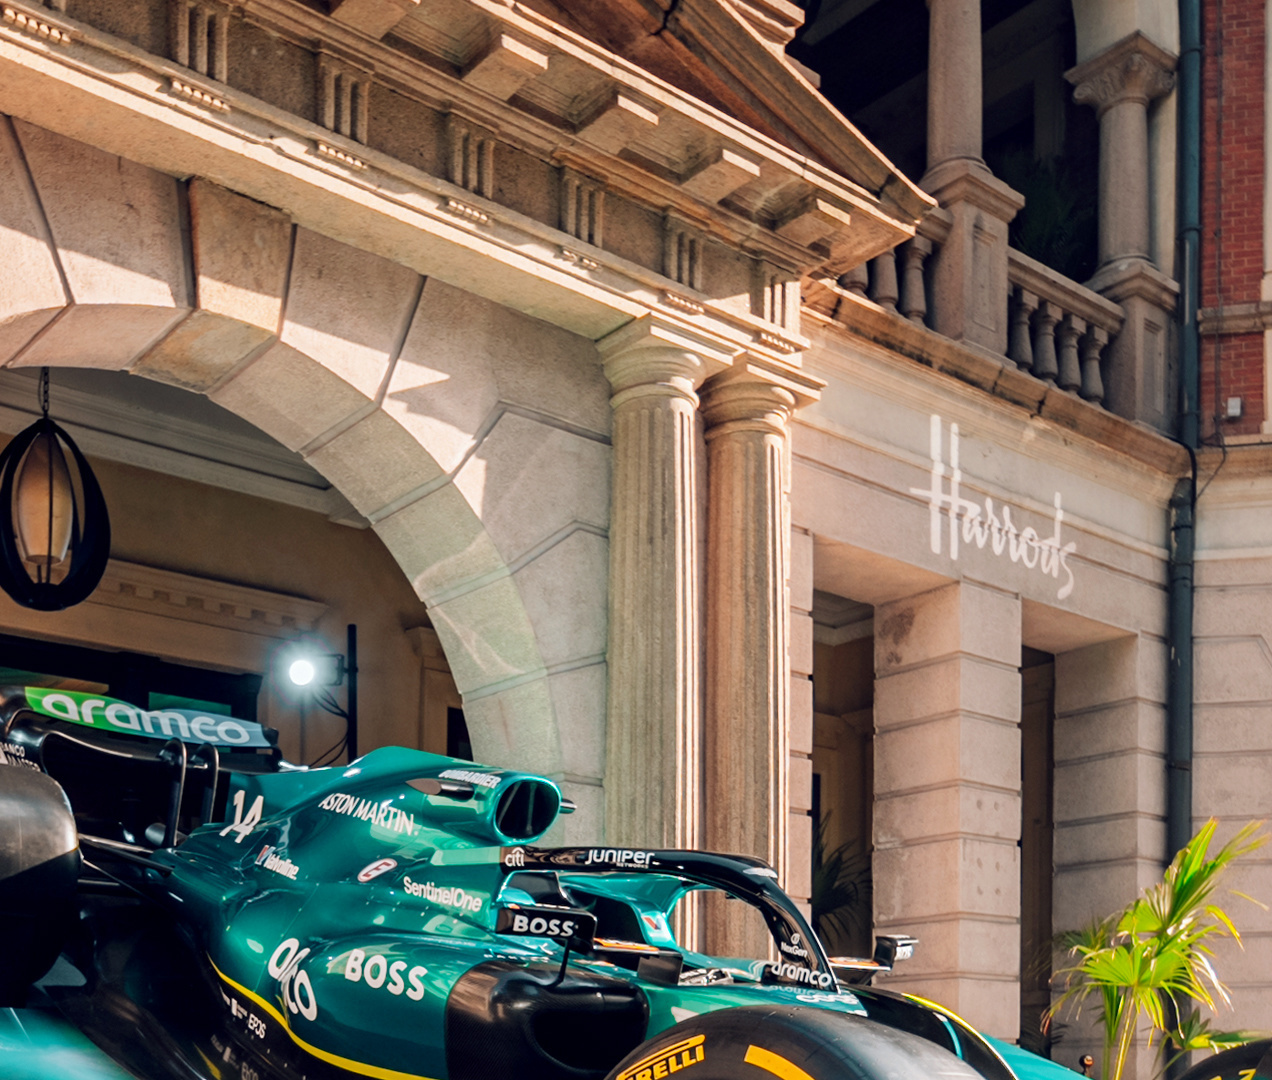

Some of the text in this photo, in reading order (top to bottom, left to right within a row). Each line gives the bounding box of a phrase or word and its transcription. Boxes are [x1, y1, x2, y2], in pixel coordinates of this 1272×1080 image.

[910, 413, 1077, 599] Harrods
[41, 692, 251, 744] aramco
[219, 789, 264, 843] 14
[318, 792, 360, 816] ASTON
[505, 847, 525, 867] citi
[403, 875, 483, 912] SentinelOne
[512, 914, 575, 937] BOSS
[344, 948, 428, 1001] BOSS
[770, 962, 832, 987] aramco
